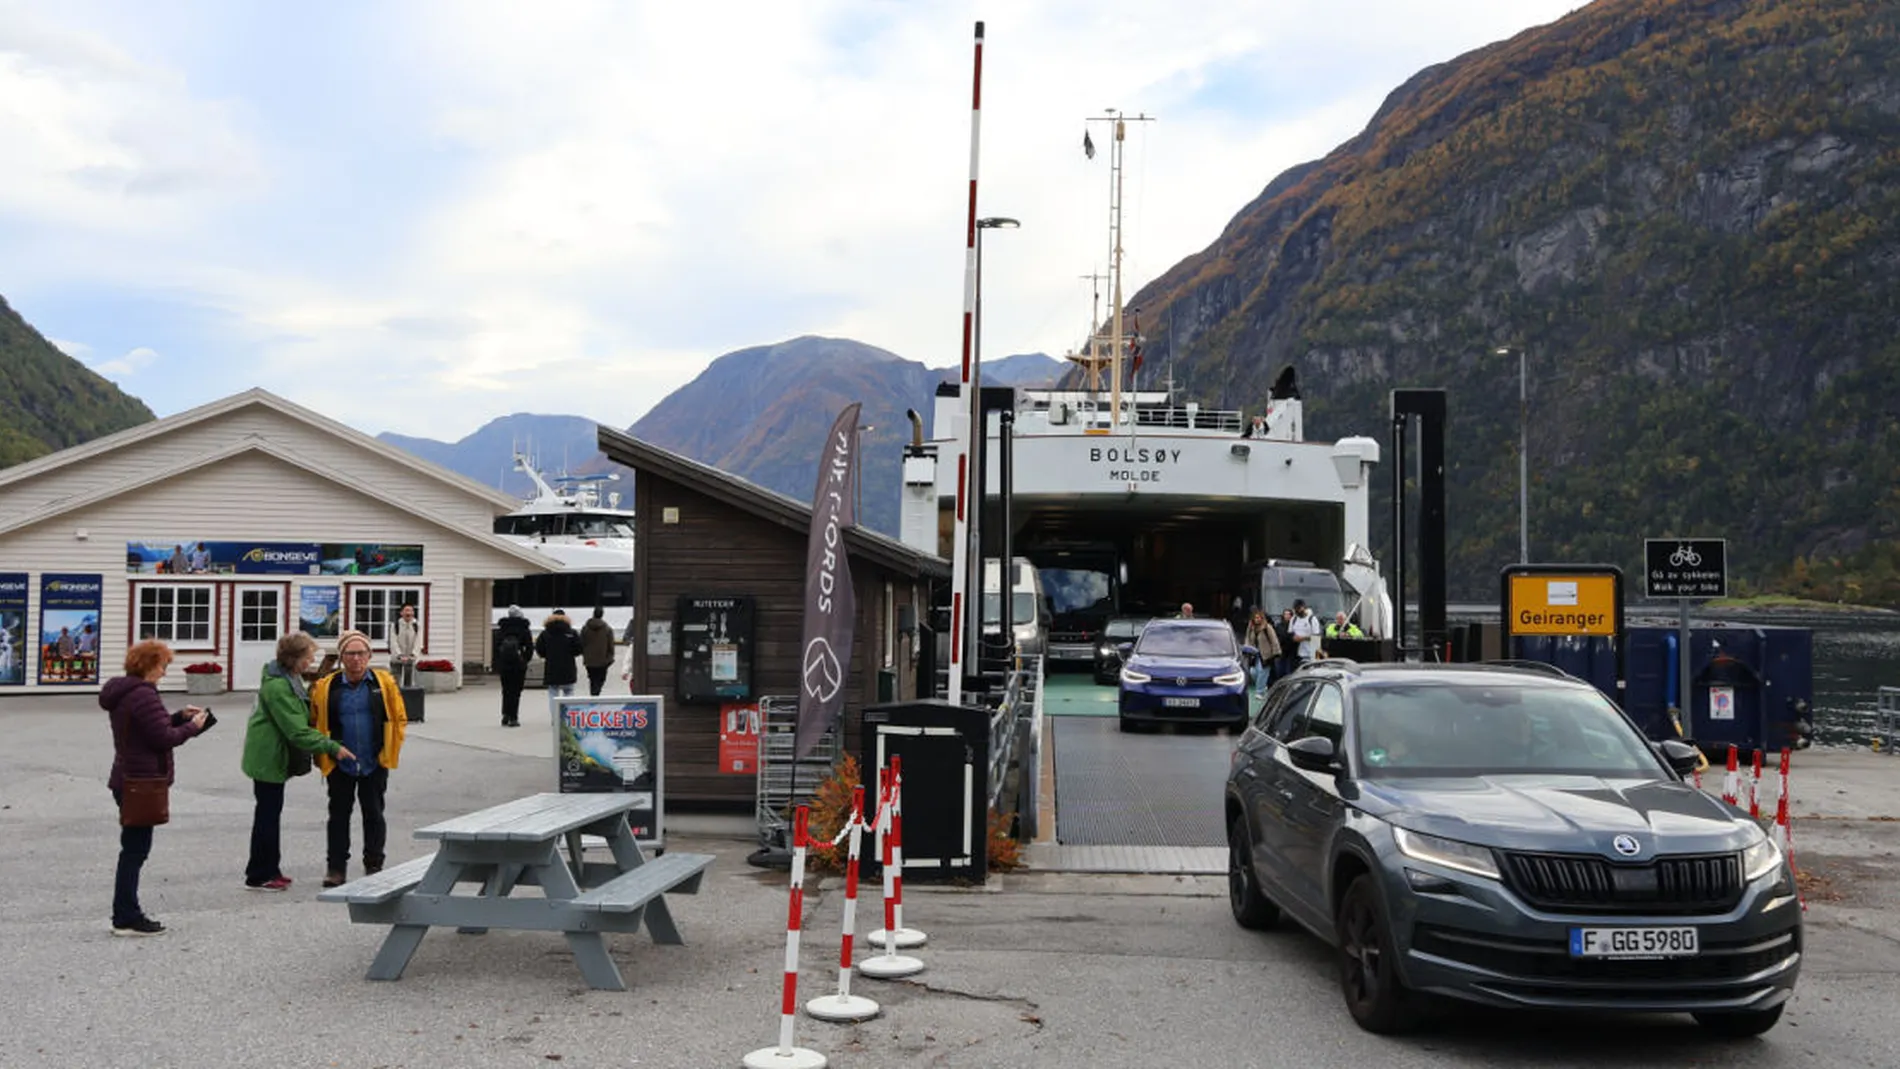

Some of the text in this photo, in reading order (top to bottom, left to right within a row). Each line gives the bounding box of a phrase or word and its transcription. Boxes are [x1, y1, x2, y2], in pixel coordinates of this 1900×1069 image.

[1090, 448, 1181, 463] BOLSØY
[1109, 470, 1160, 481] MOLDE
[1653, 582, 1719, 593] Walk your bike
[1520, 610, 1604, 628] Geiranger
[567, 710, 648, 728] TICKETS
[1584, 930, 1694, 951] F GG 5980
